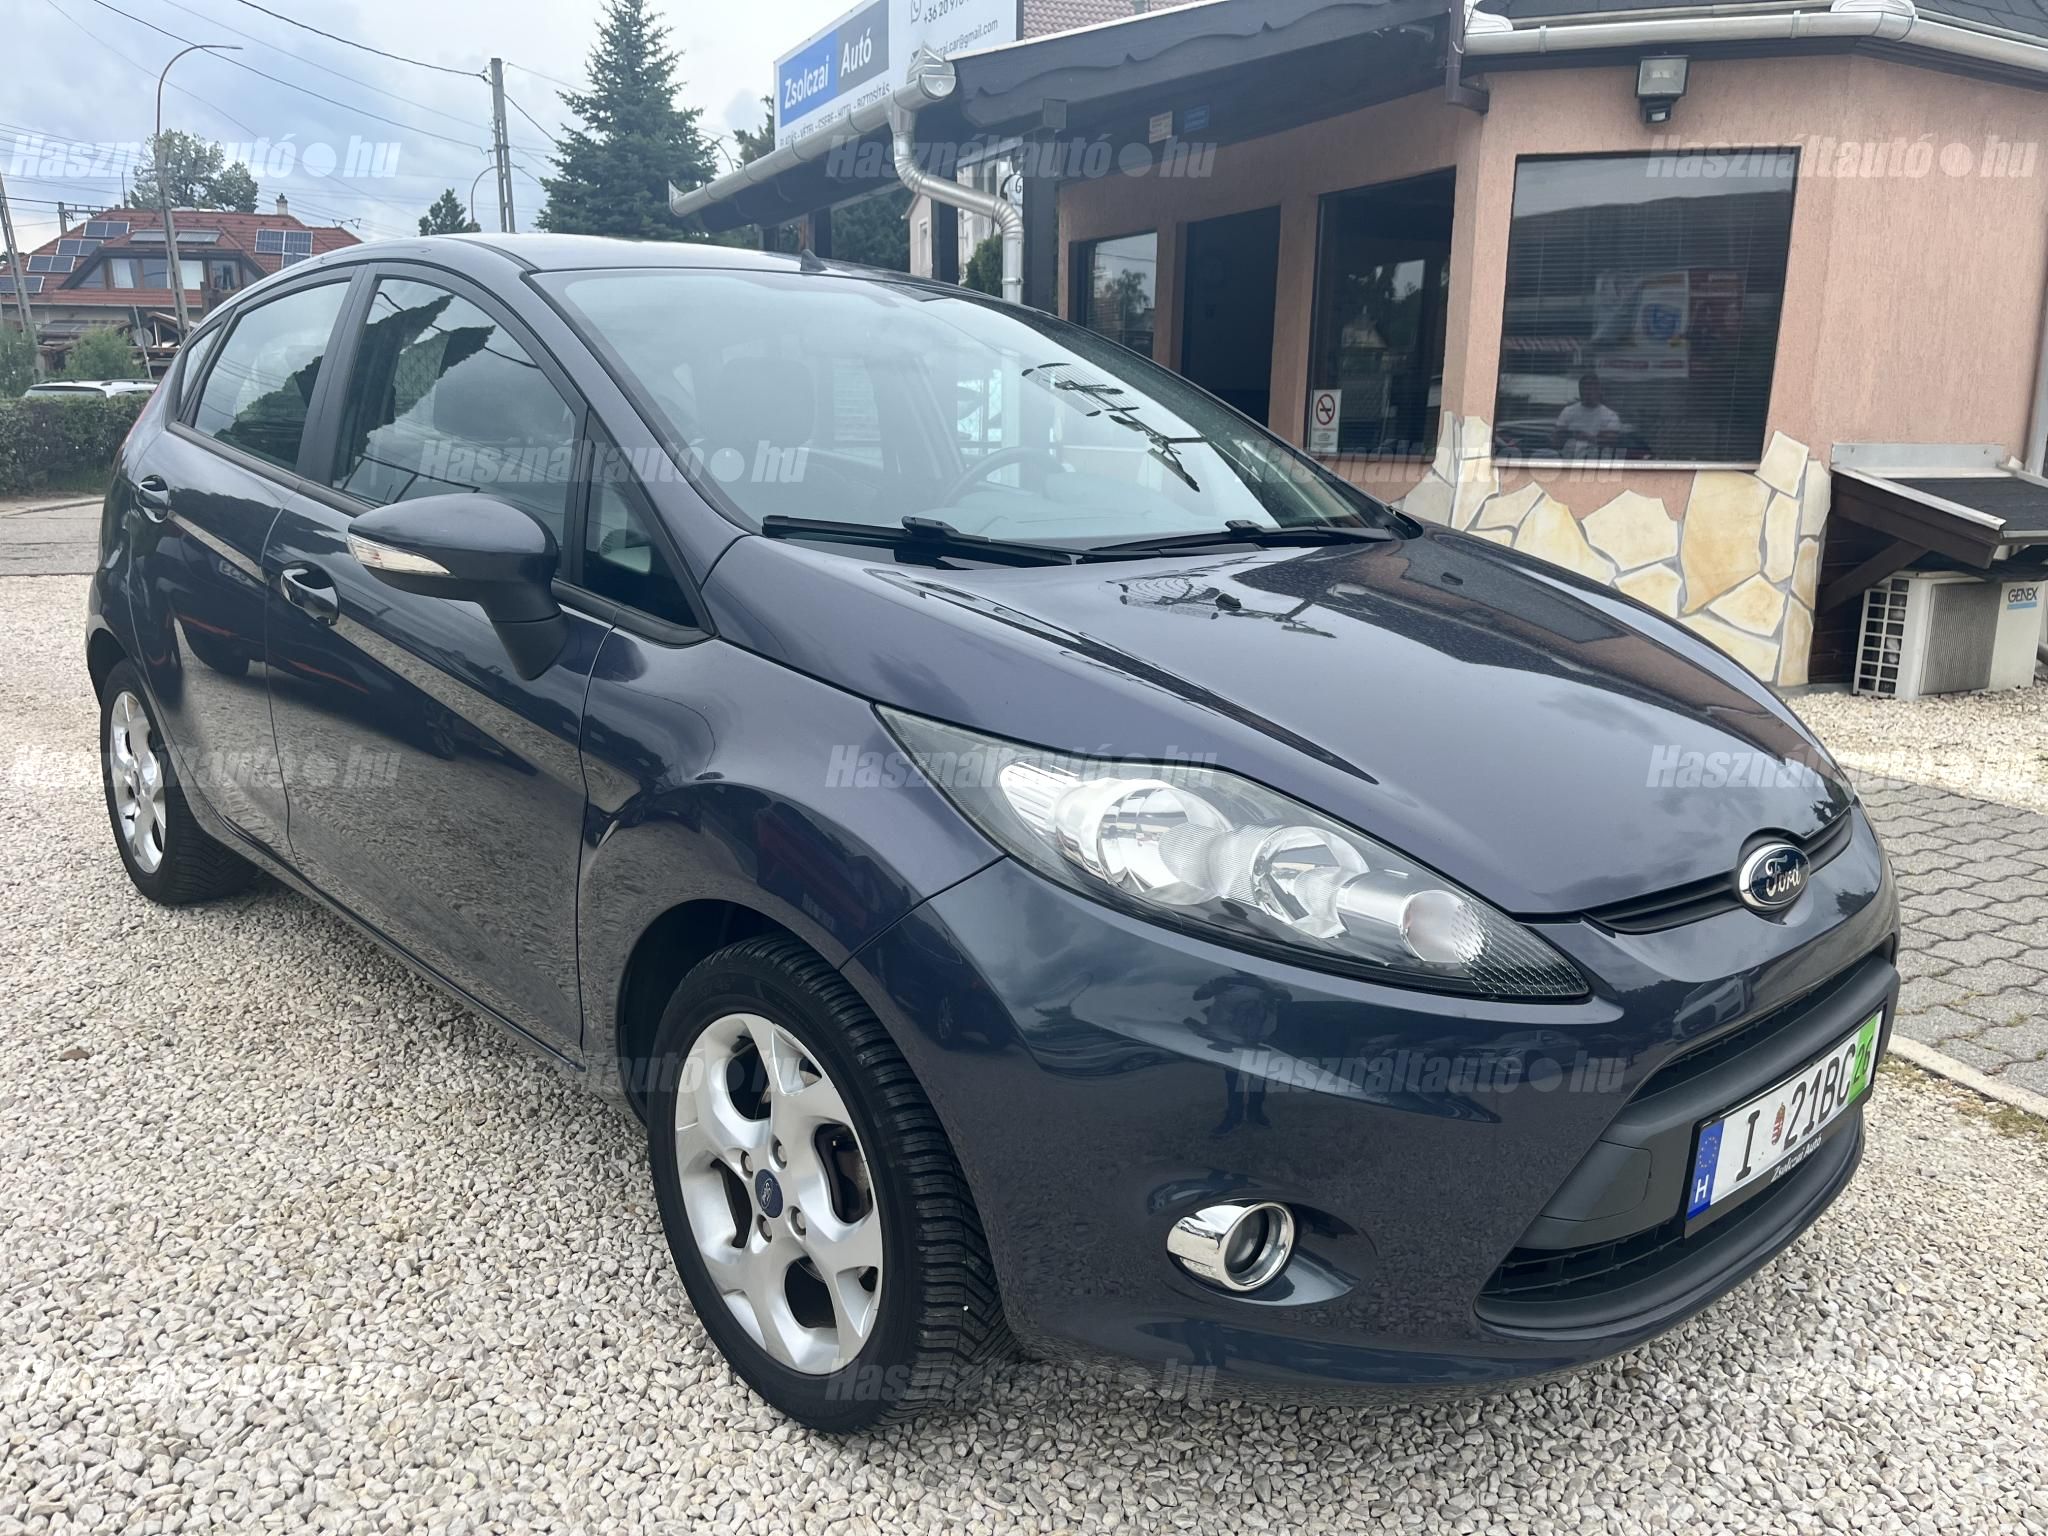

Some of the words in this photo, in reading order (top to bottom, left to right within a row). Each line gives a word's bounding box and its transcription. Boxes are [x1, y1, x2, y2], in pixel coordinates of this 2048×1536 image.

[784, 55, 829, 110] Zsolczai
[840, 28, 872, 77] Autó
[2008, 586, 2039, 603] GENEX
[1765, 854, 1801, 896] Ford
[1694, 1174, 1710, 1203] H
